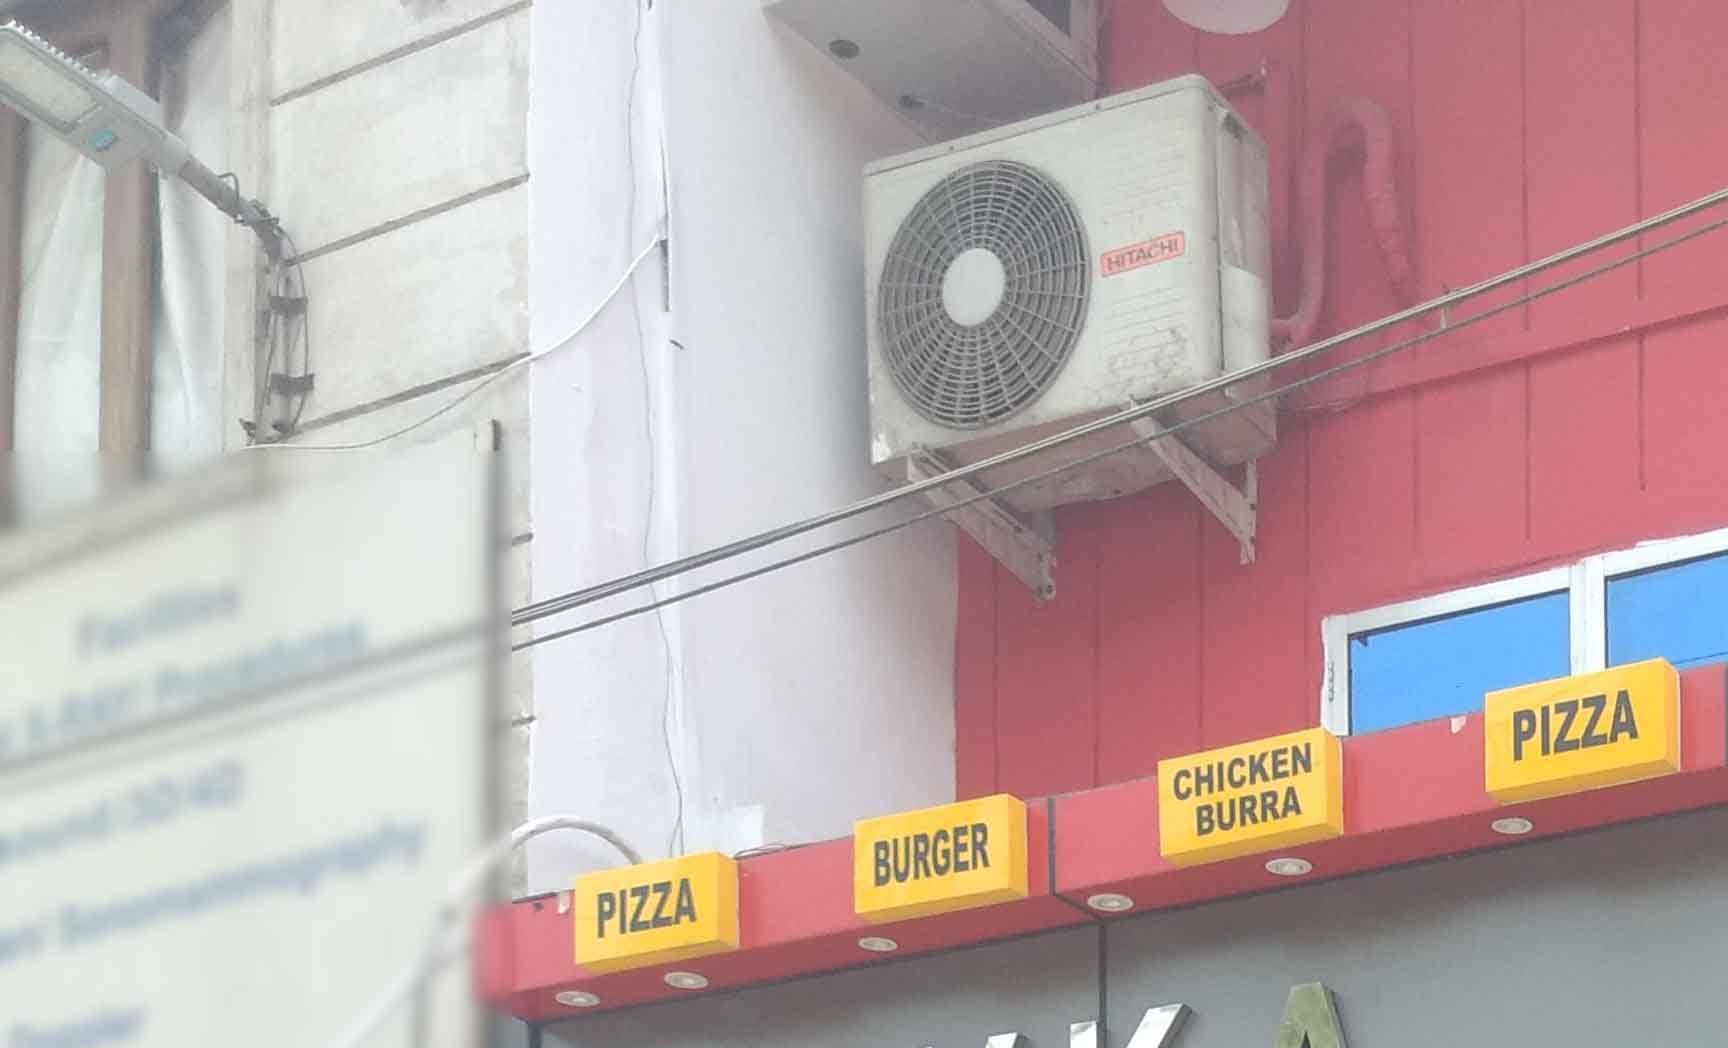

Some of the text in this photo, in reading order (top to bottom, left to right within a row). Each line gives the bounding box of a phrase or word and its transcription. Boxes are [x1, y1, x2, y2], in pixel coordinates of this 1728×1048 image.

[1106, 238, 1179, 272] HITACHI
[1511, 688, 1640, 762] PIZZA
[1172, 741, 1314, 800] CHICKEN
[1194, 783, 1303, 837] BURRA
[872, 822, 990, 888] BURGER
[595, 877, 697, 939] PIZZA
